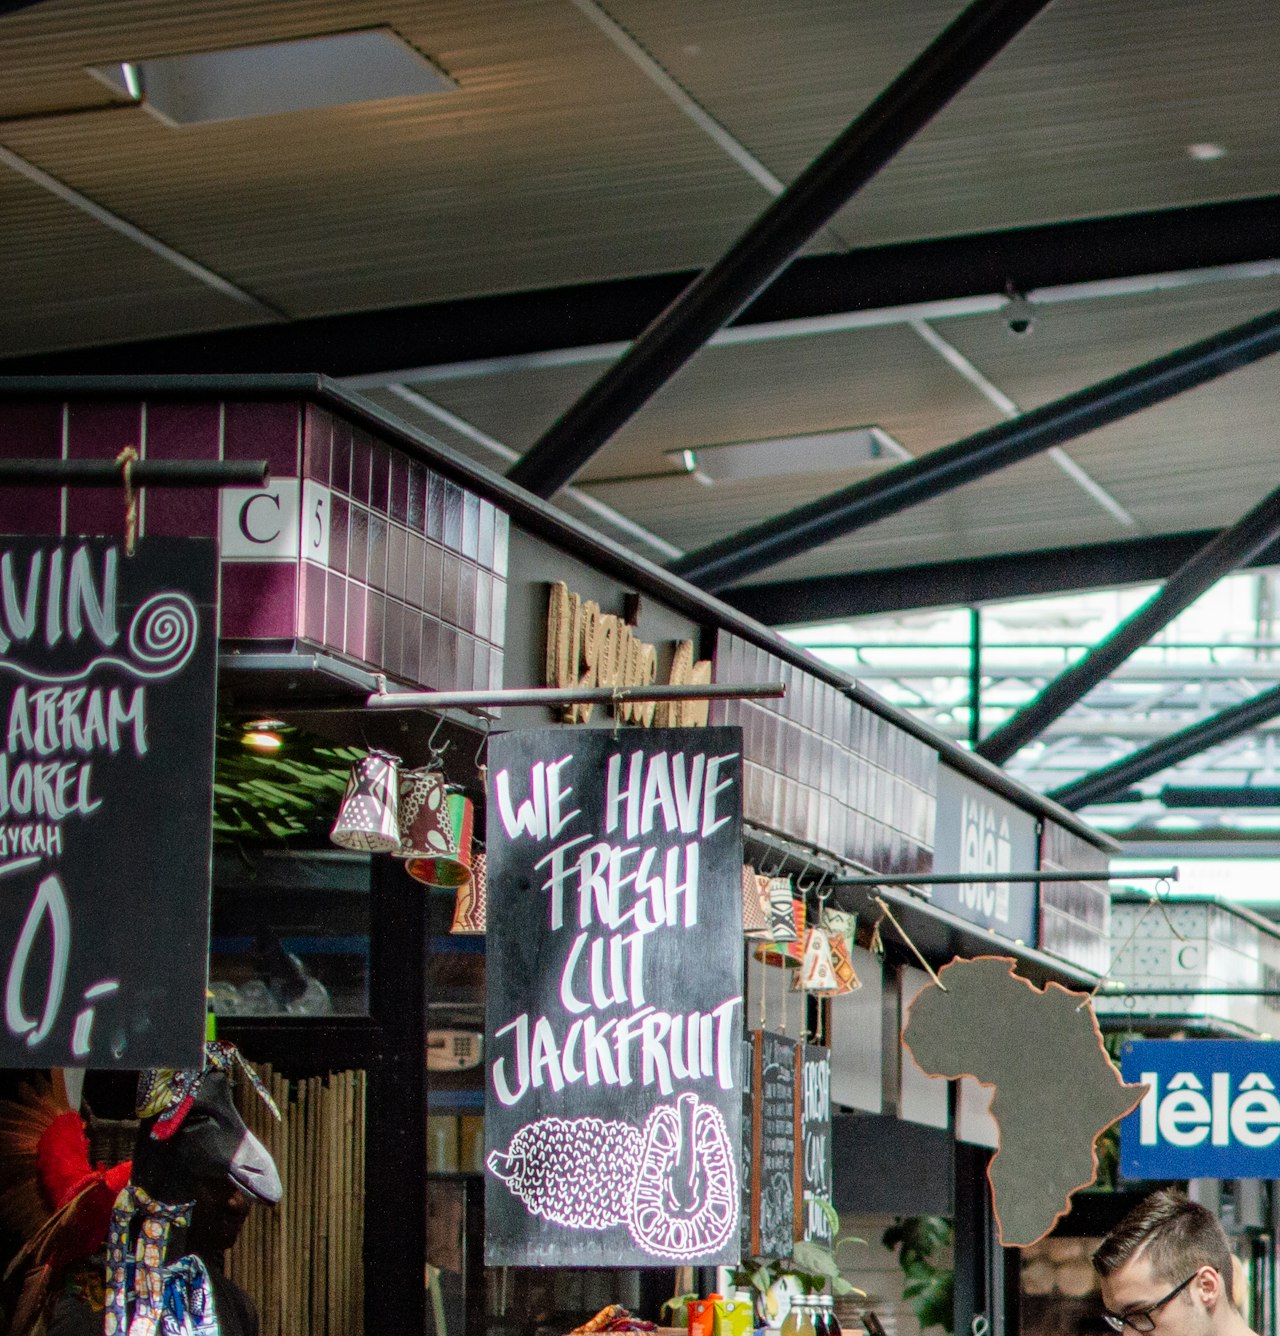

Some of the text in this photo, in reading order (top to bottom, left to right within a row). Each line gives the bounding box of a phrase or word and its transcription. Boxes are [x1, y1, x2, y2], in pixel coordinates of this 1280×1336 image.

[239, 493, 281, 544] C
[313, 498, 323, 548] 5
[496, 750, 740, 841] WE HAVE
[534, 834, 699, 931] FRESH
[561, 929, 656, 1014] CUT
[1178, 946, 1198, 970] C
[493, 997, 743, 1106] JACKFRUIT
